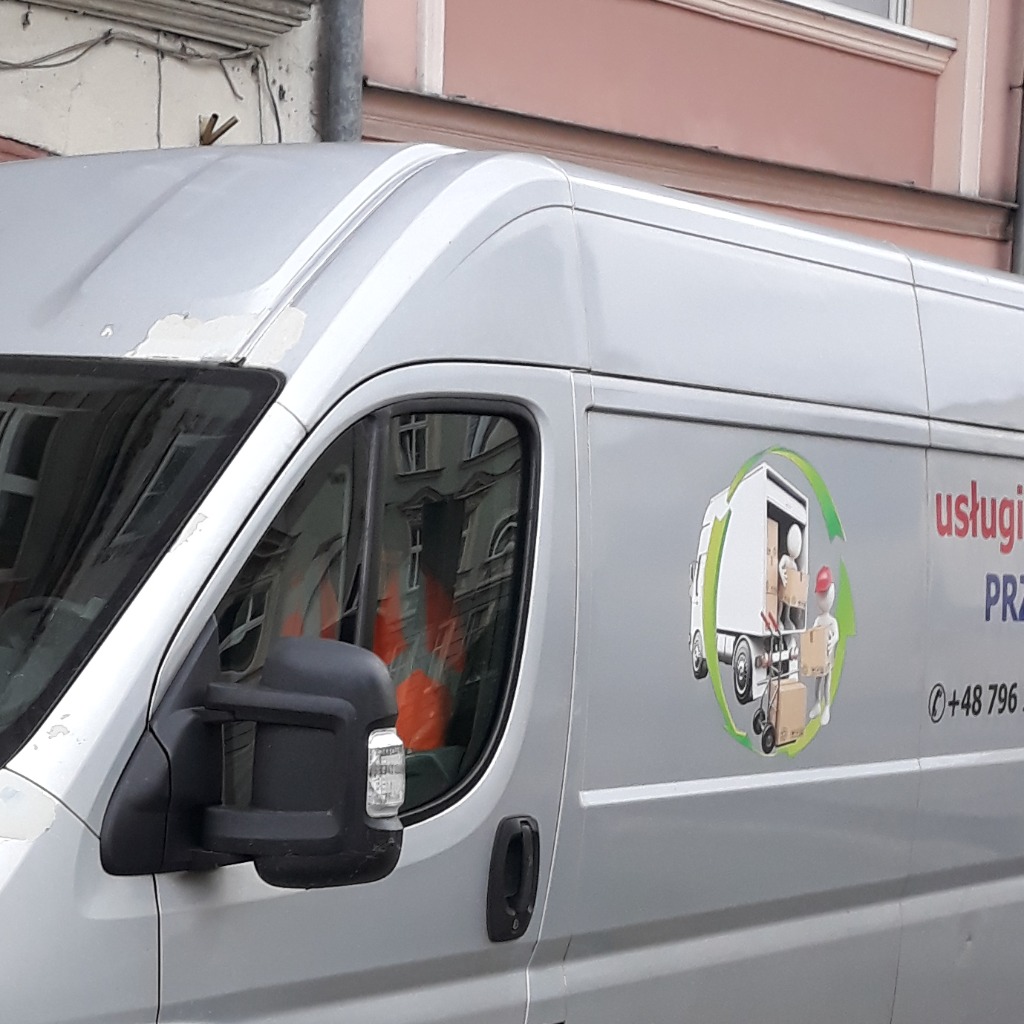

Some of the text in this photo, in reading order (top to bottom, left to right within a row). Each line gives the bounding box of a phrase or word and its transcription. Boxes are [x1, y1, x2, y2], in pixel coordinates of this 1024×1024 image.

[935, 479, 1023, 555] usługi
[948, 682, 1017, 717] +48 796
